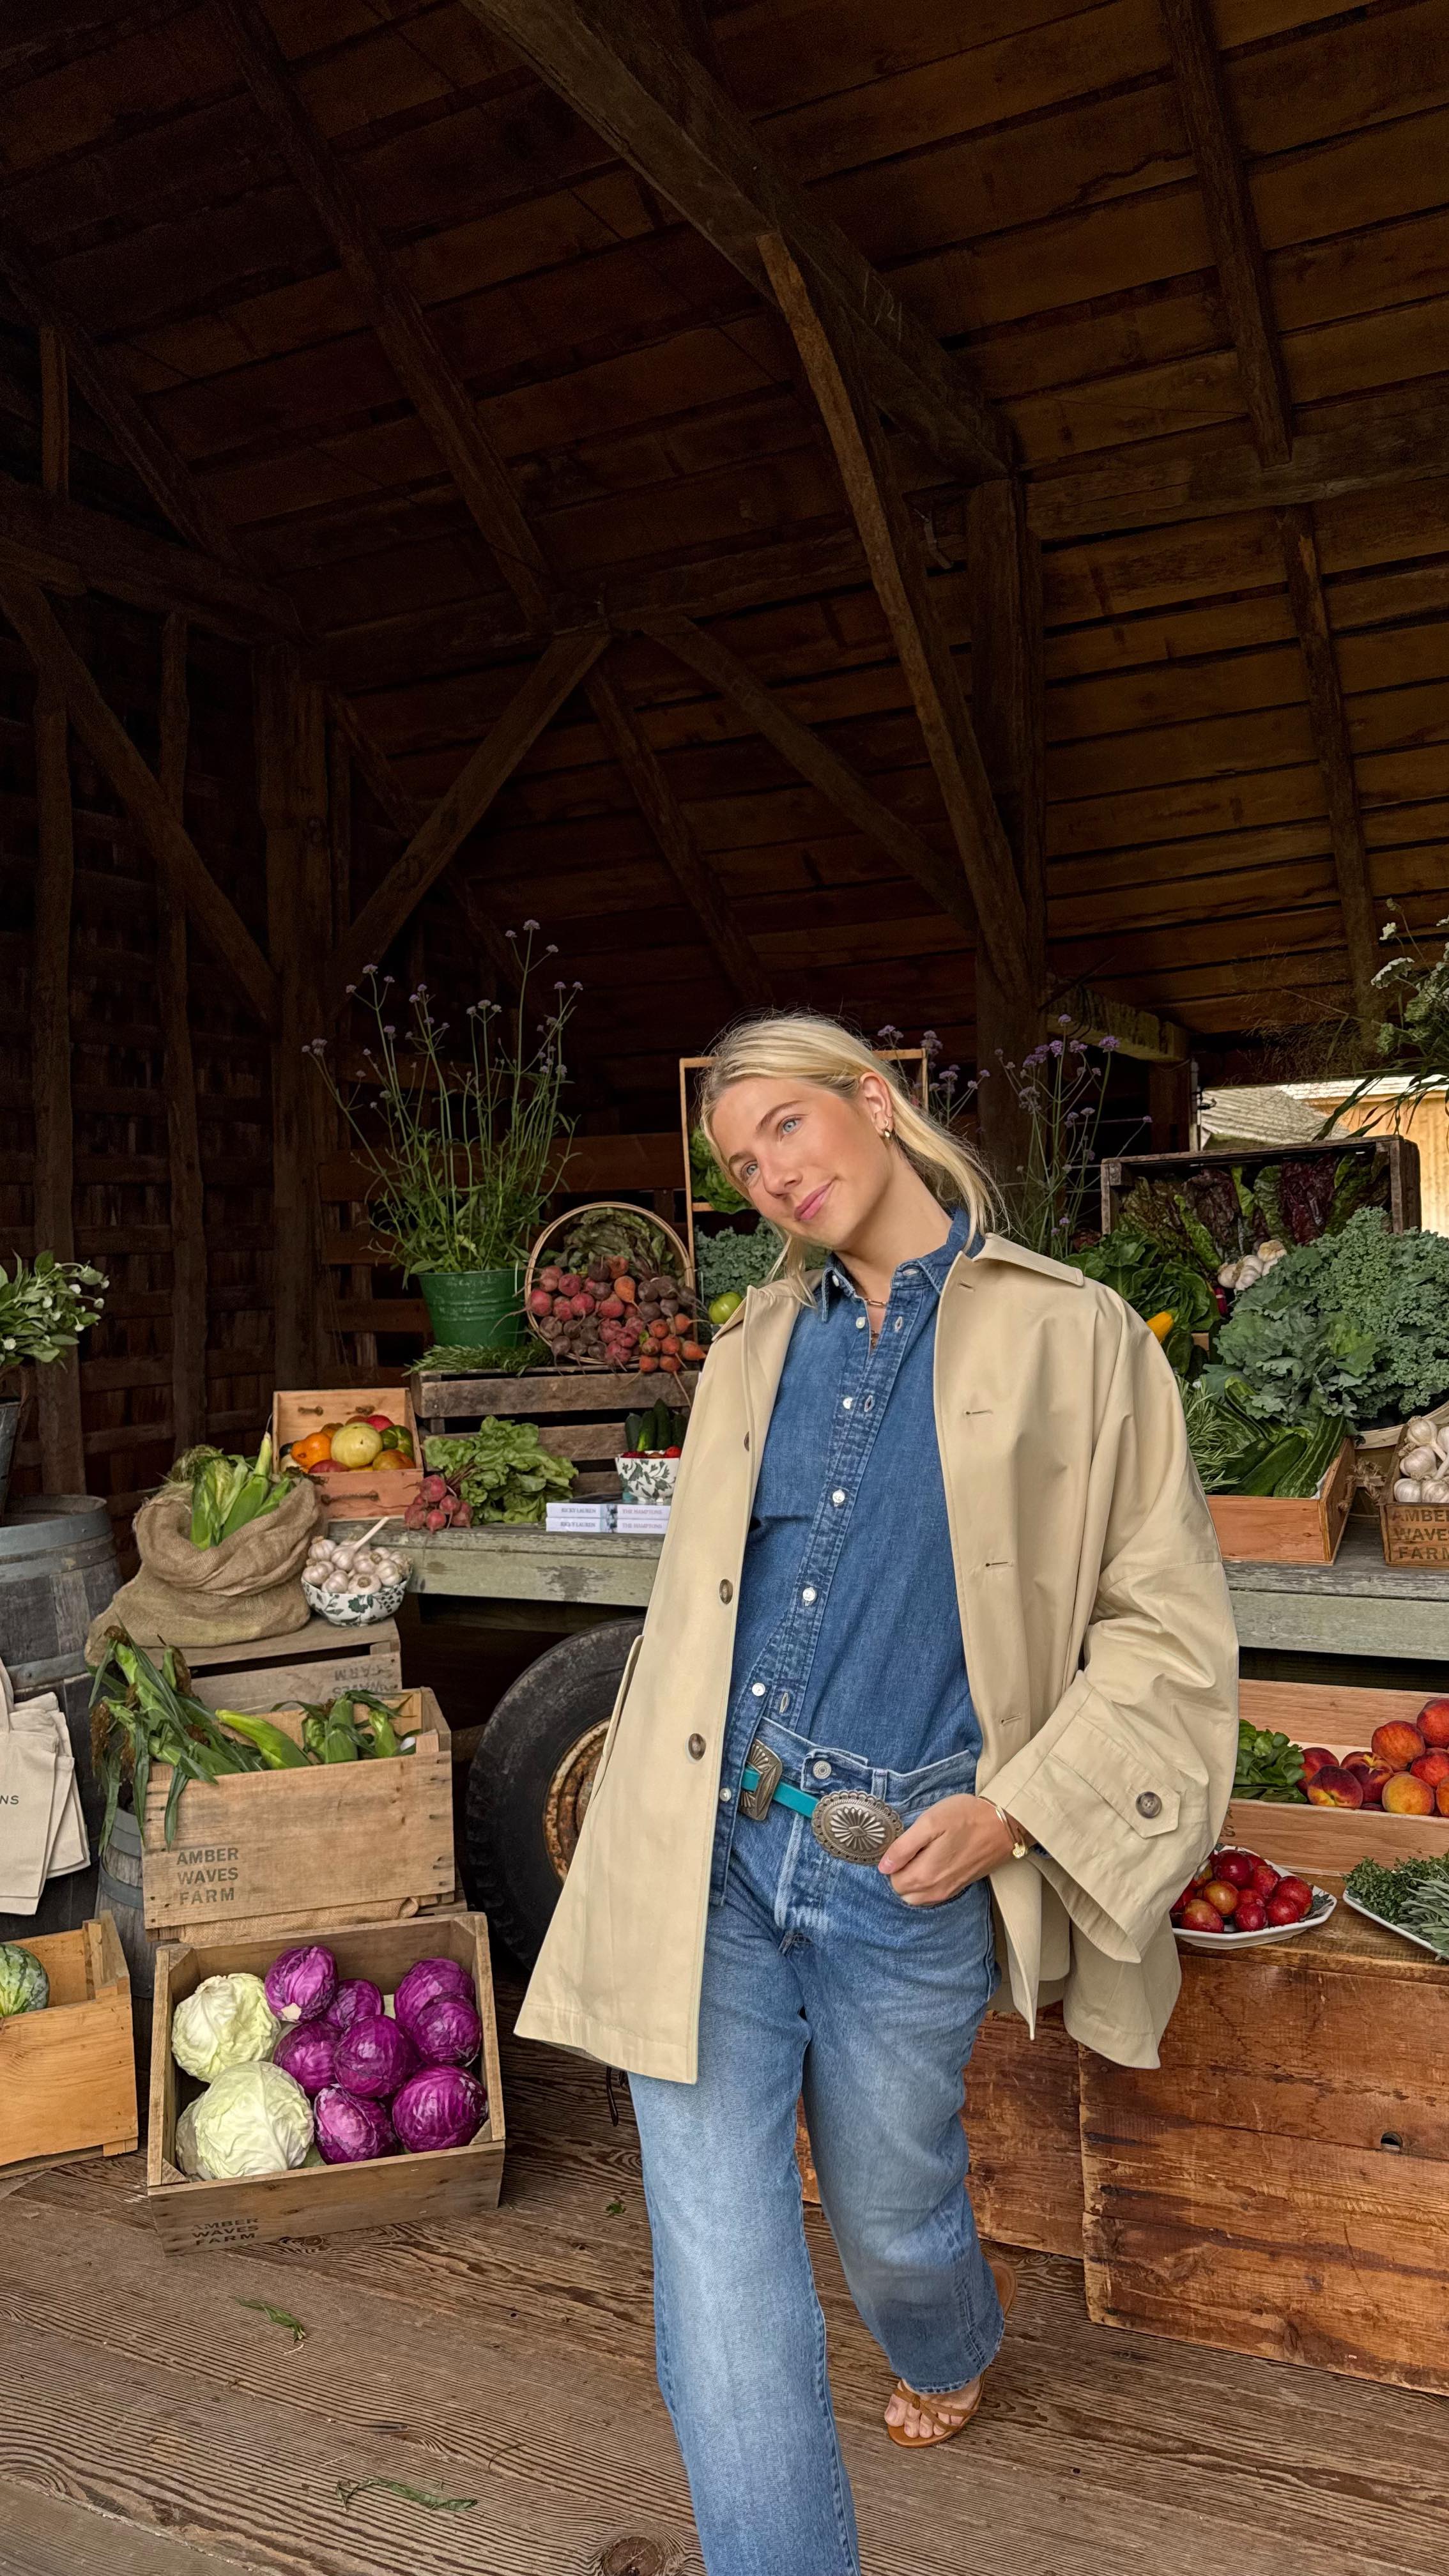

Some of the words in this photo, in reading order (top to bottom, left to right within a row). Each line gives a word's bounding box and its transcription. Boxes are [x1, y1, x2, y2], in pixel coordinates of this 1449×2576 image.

[1392, 1508, 1449, 1522] AMBE
[1393, 1528, 1449, 1541] WAVE
[176, 1847, 239, 1865] AMBER
[178, 1867, 239, 1885] WAVES
[179, 1887, 234, 1905] FARM
[191, 2218, 259, 2232] AMBER
[192, 2225, 259, 2238] WAVES
[195, 2233, 256, 2246] FARM
